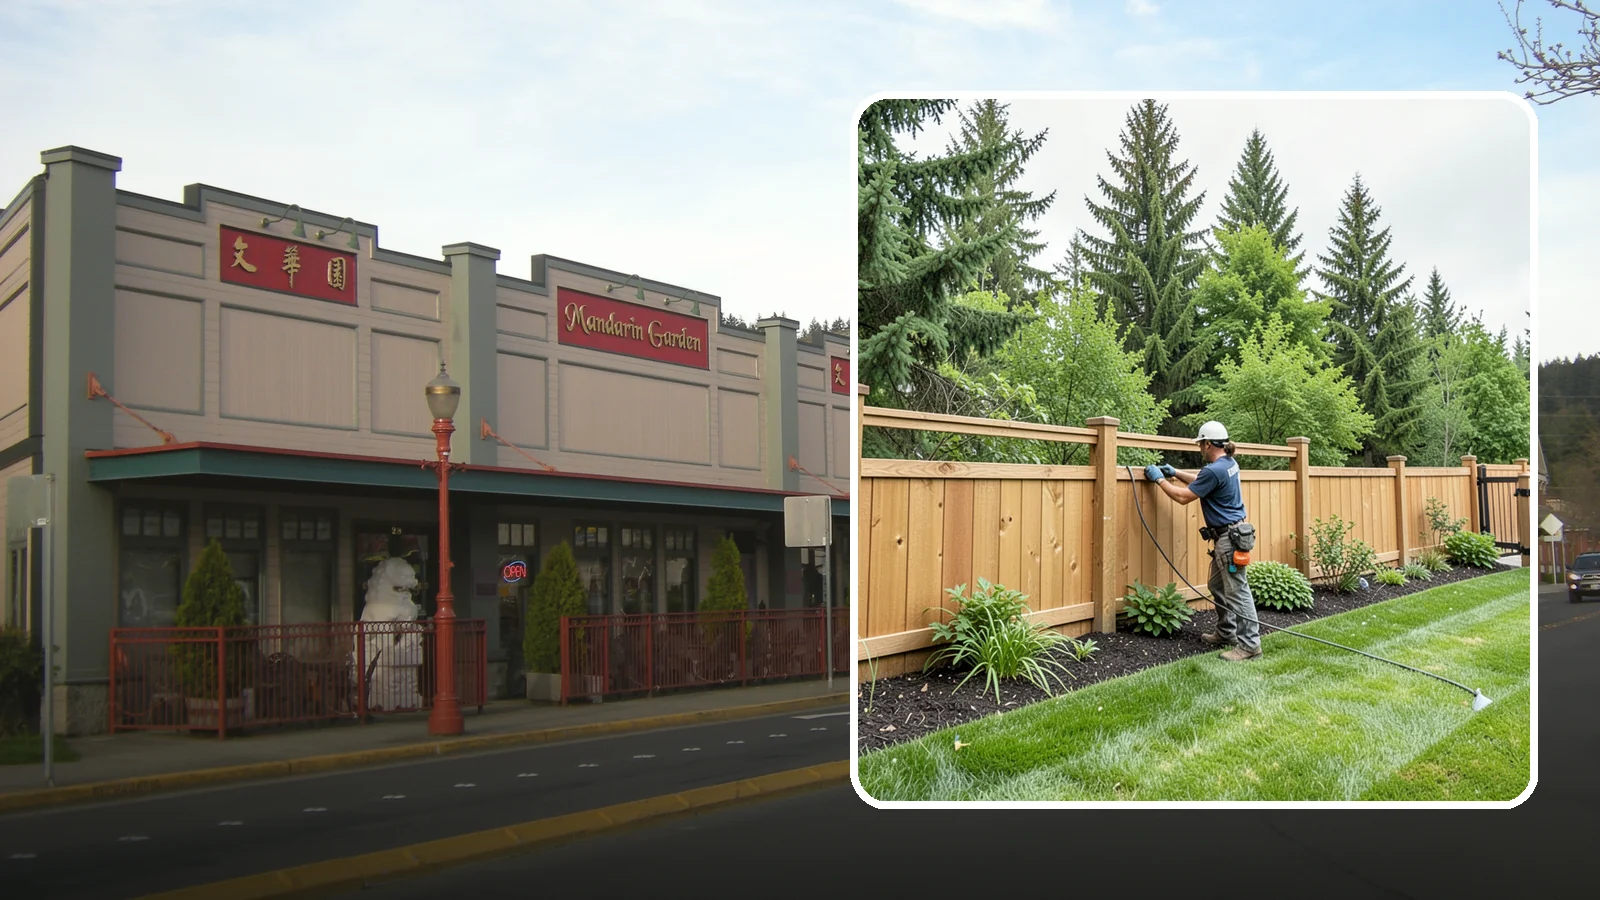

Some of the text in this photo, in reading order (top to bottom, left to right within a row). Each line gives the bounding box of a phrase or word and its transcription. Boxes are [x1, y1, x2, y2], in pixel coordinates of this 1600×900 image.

[231, 235, 346, 291] 文華園
[564, 302, 701, 352] Mandarin Garden
[503, 565, 526, 578] OPEN
